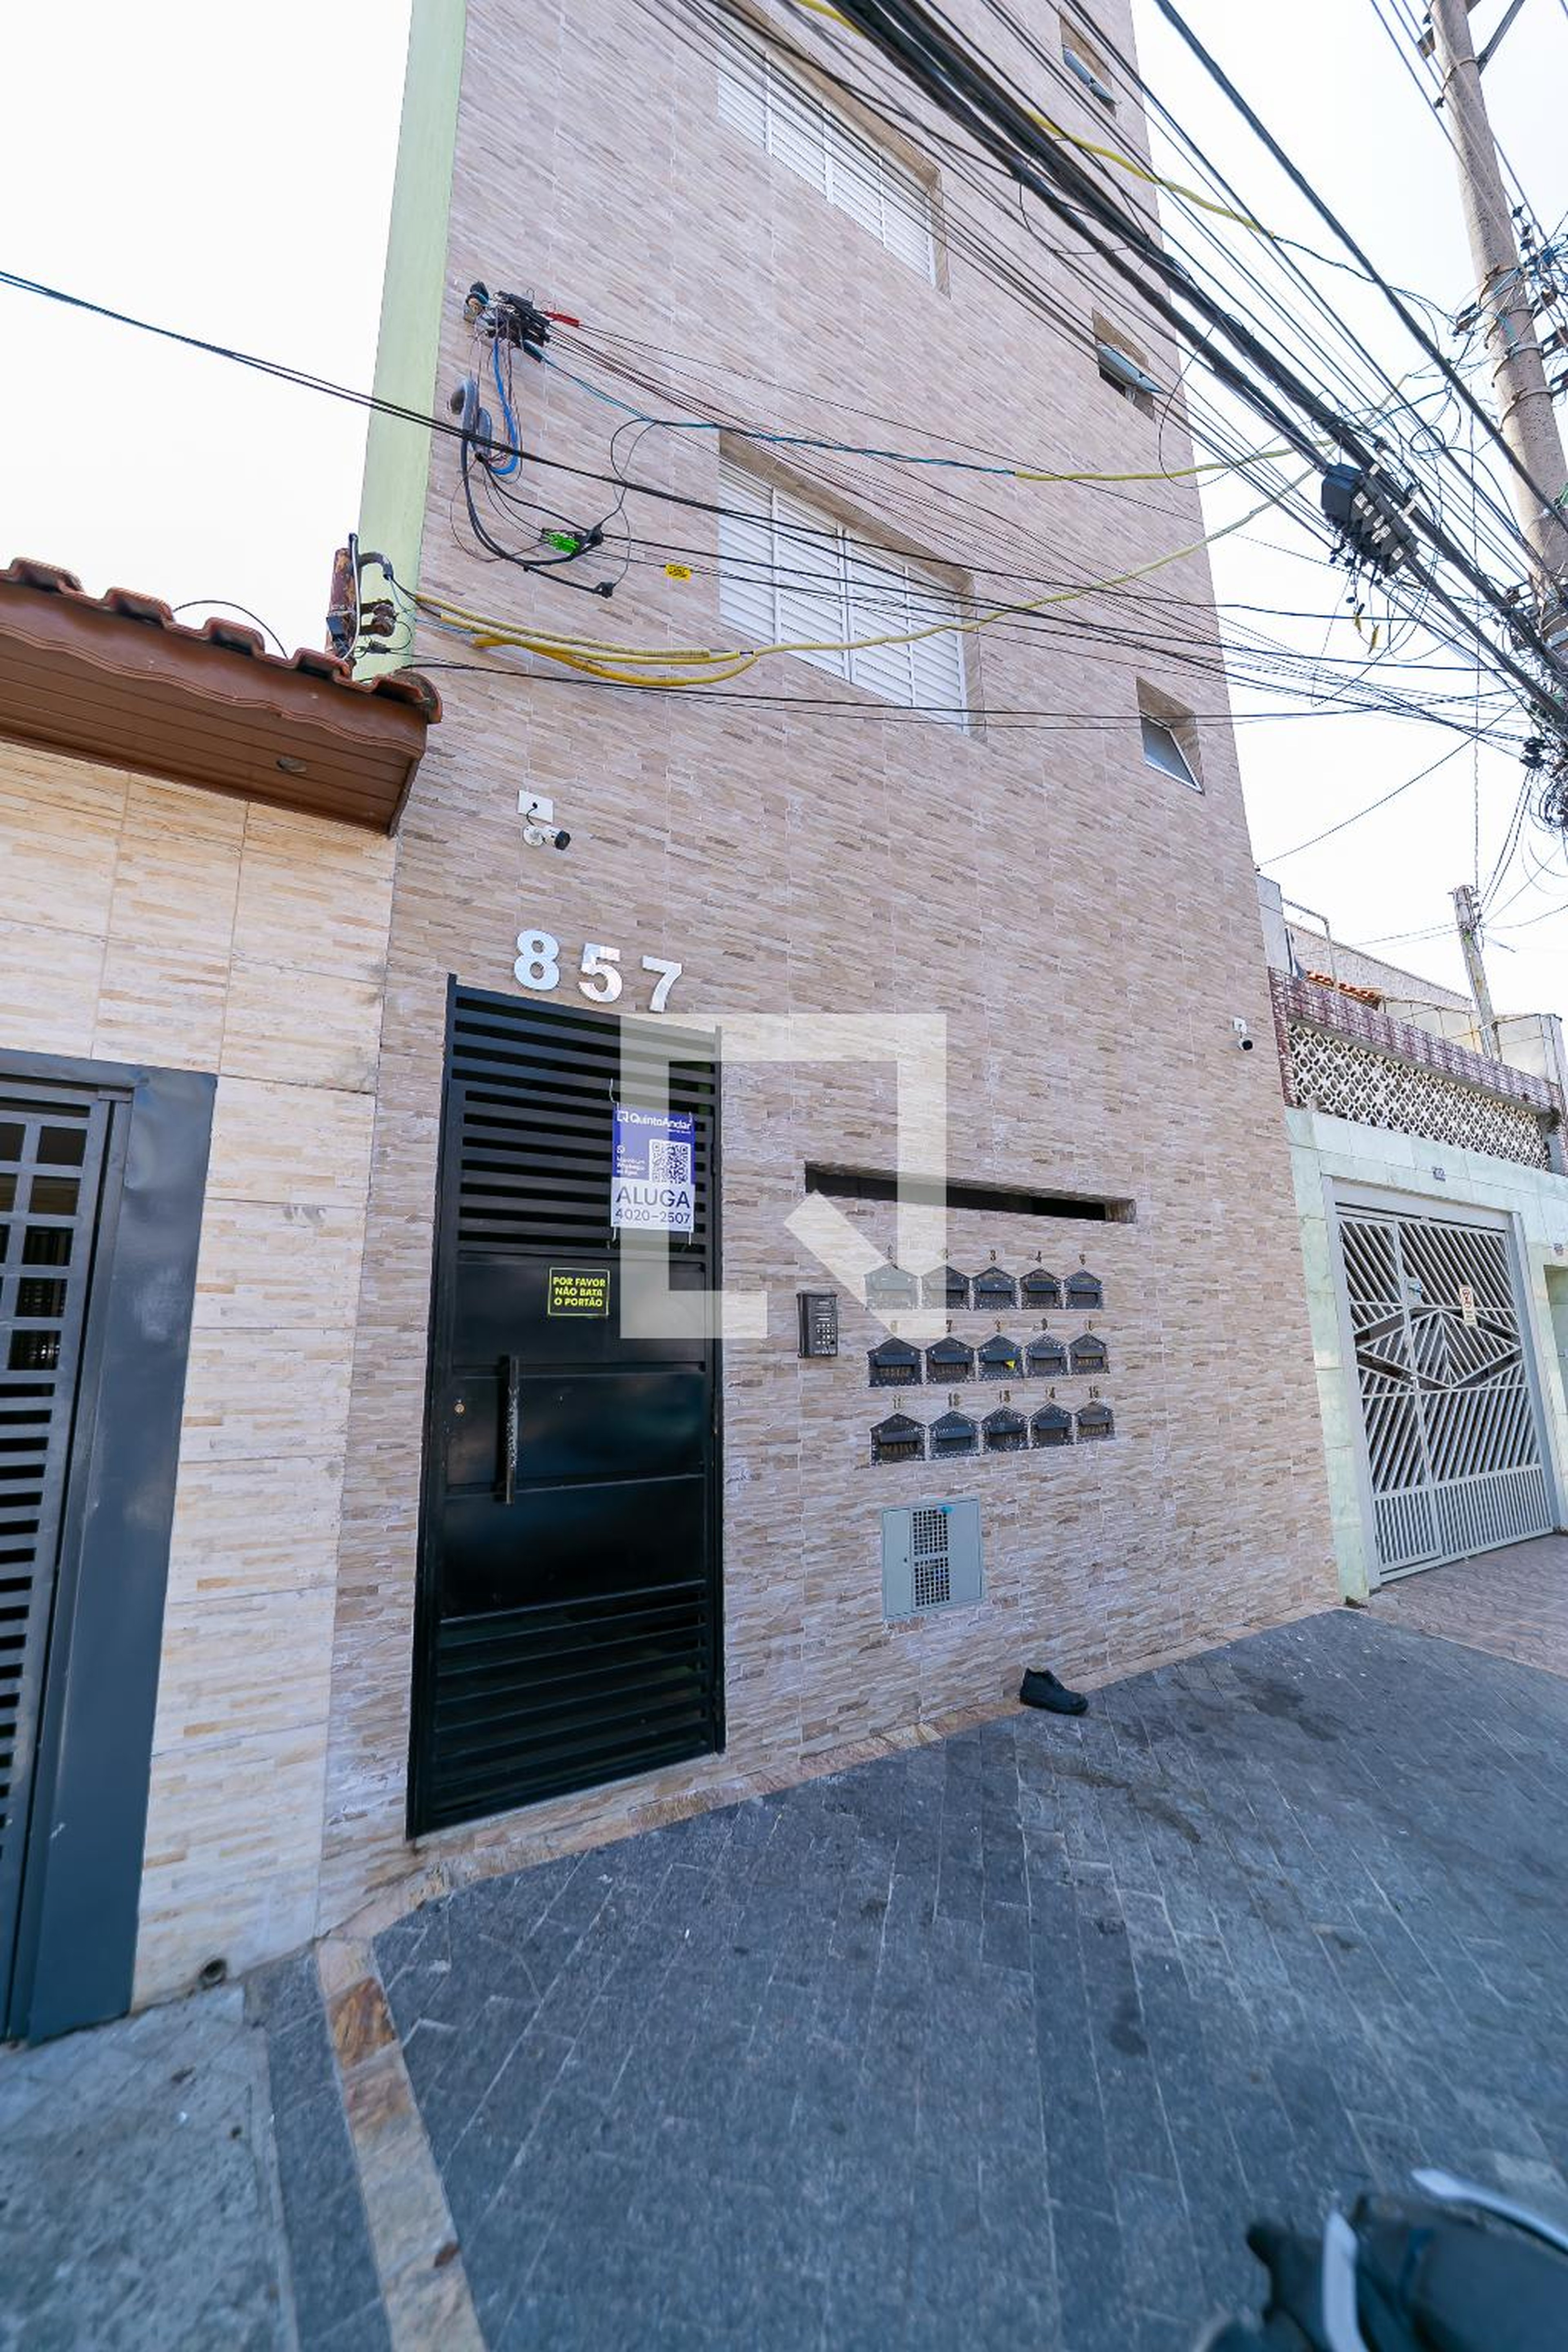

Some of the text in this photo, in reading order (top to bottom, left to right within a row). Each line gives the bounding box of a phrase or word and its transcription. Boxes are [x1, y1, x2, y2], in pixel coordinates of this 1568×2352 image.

[514, 929, 682, 1013] 857
[630, 1113, 691, 1130] QuintoAndar
[616, 1186, 690, 1208] ALUGA
[615, 1209, 690, 1223] 4020-2507
[553, 1276, 605, 1287] POR FAVOR
[555, 1287, 577, 1296] NÃO
[554, 1297, 603, 1307] O PORTÃO
